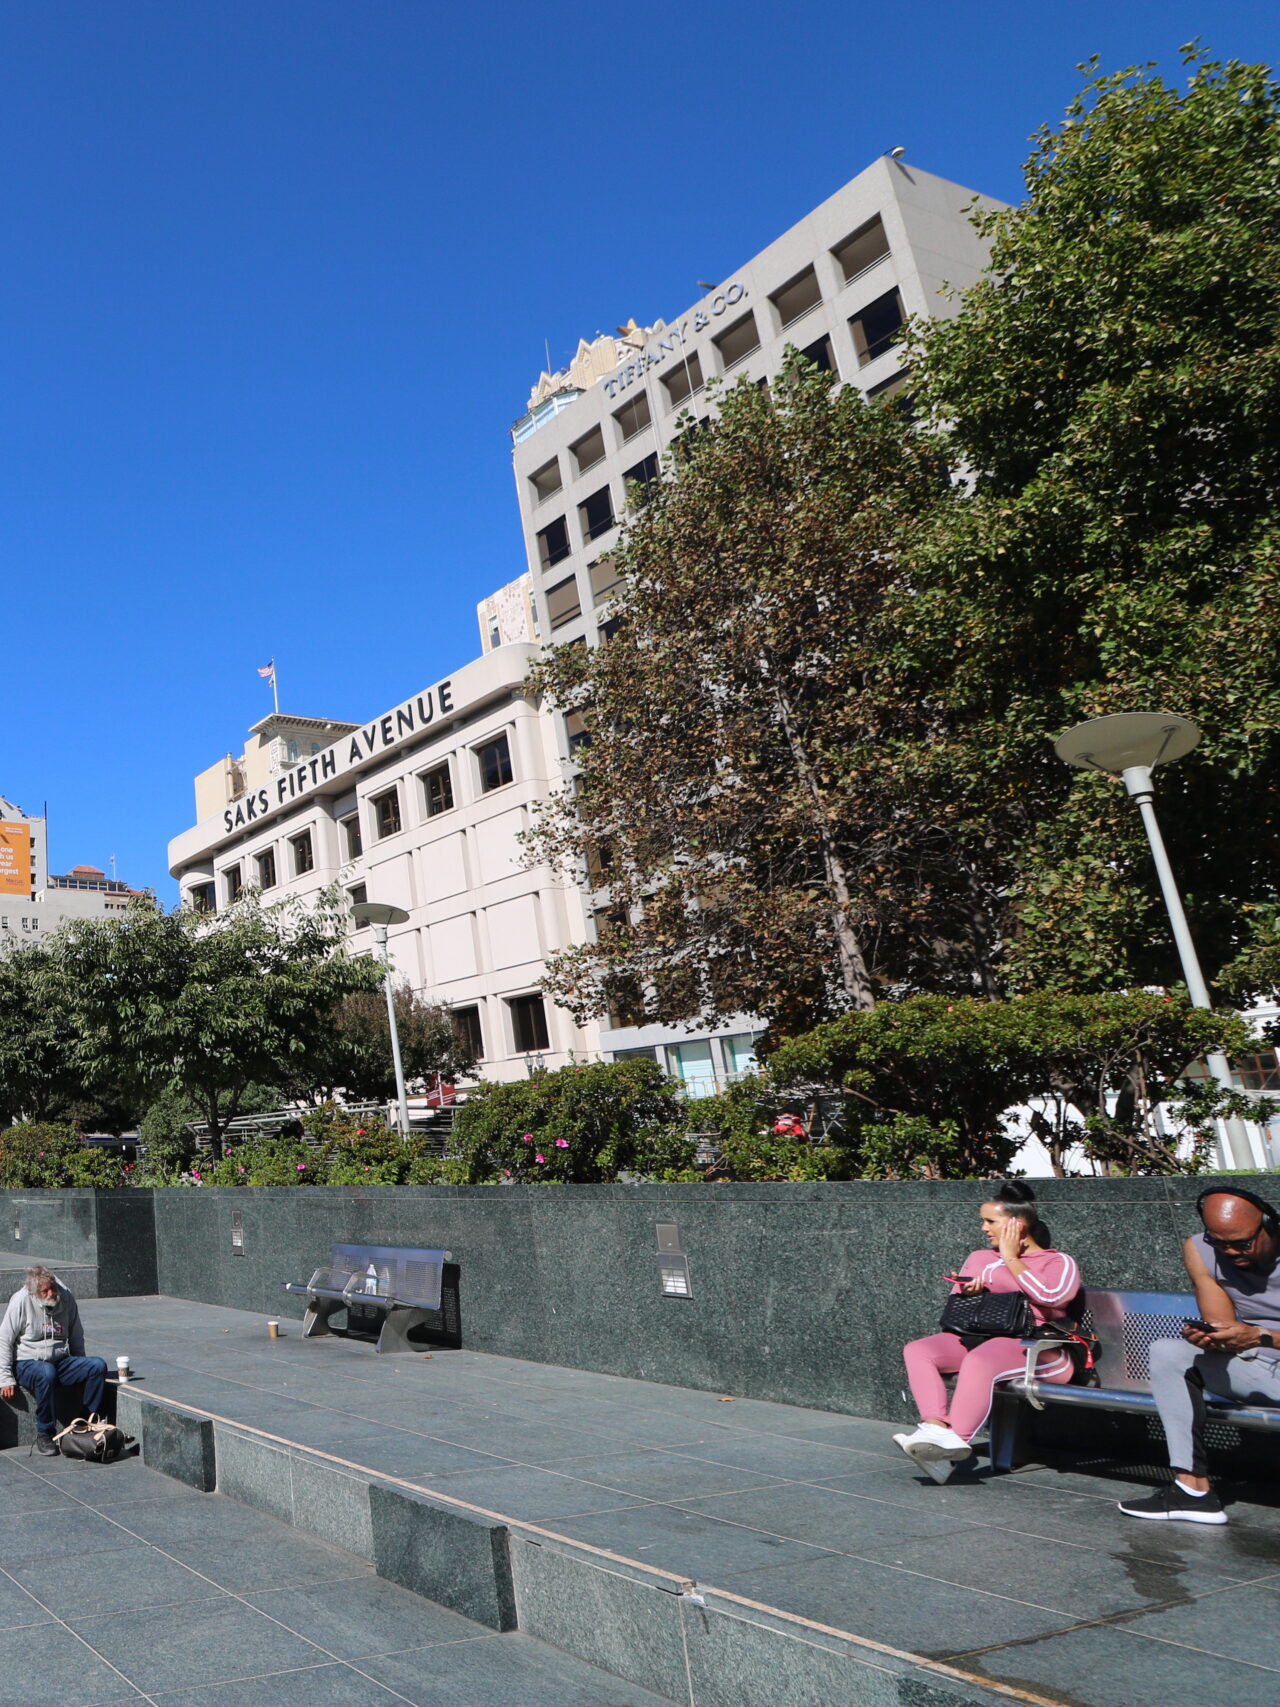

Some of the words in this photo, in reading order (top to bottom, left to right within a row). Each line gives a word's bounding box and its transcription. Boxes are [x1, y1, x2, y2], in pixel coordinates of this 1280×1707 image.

[604, 320, 688, 399] TIFFANY
[693, 312, 710, 332] &
[712, 282, 749, 316] CO.
[224, 789, 269, 833] SAKS
[277, 749, 336, 804] FIFTH
[349, 681, 454, 763] AVENUE
